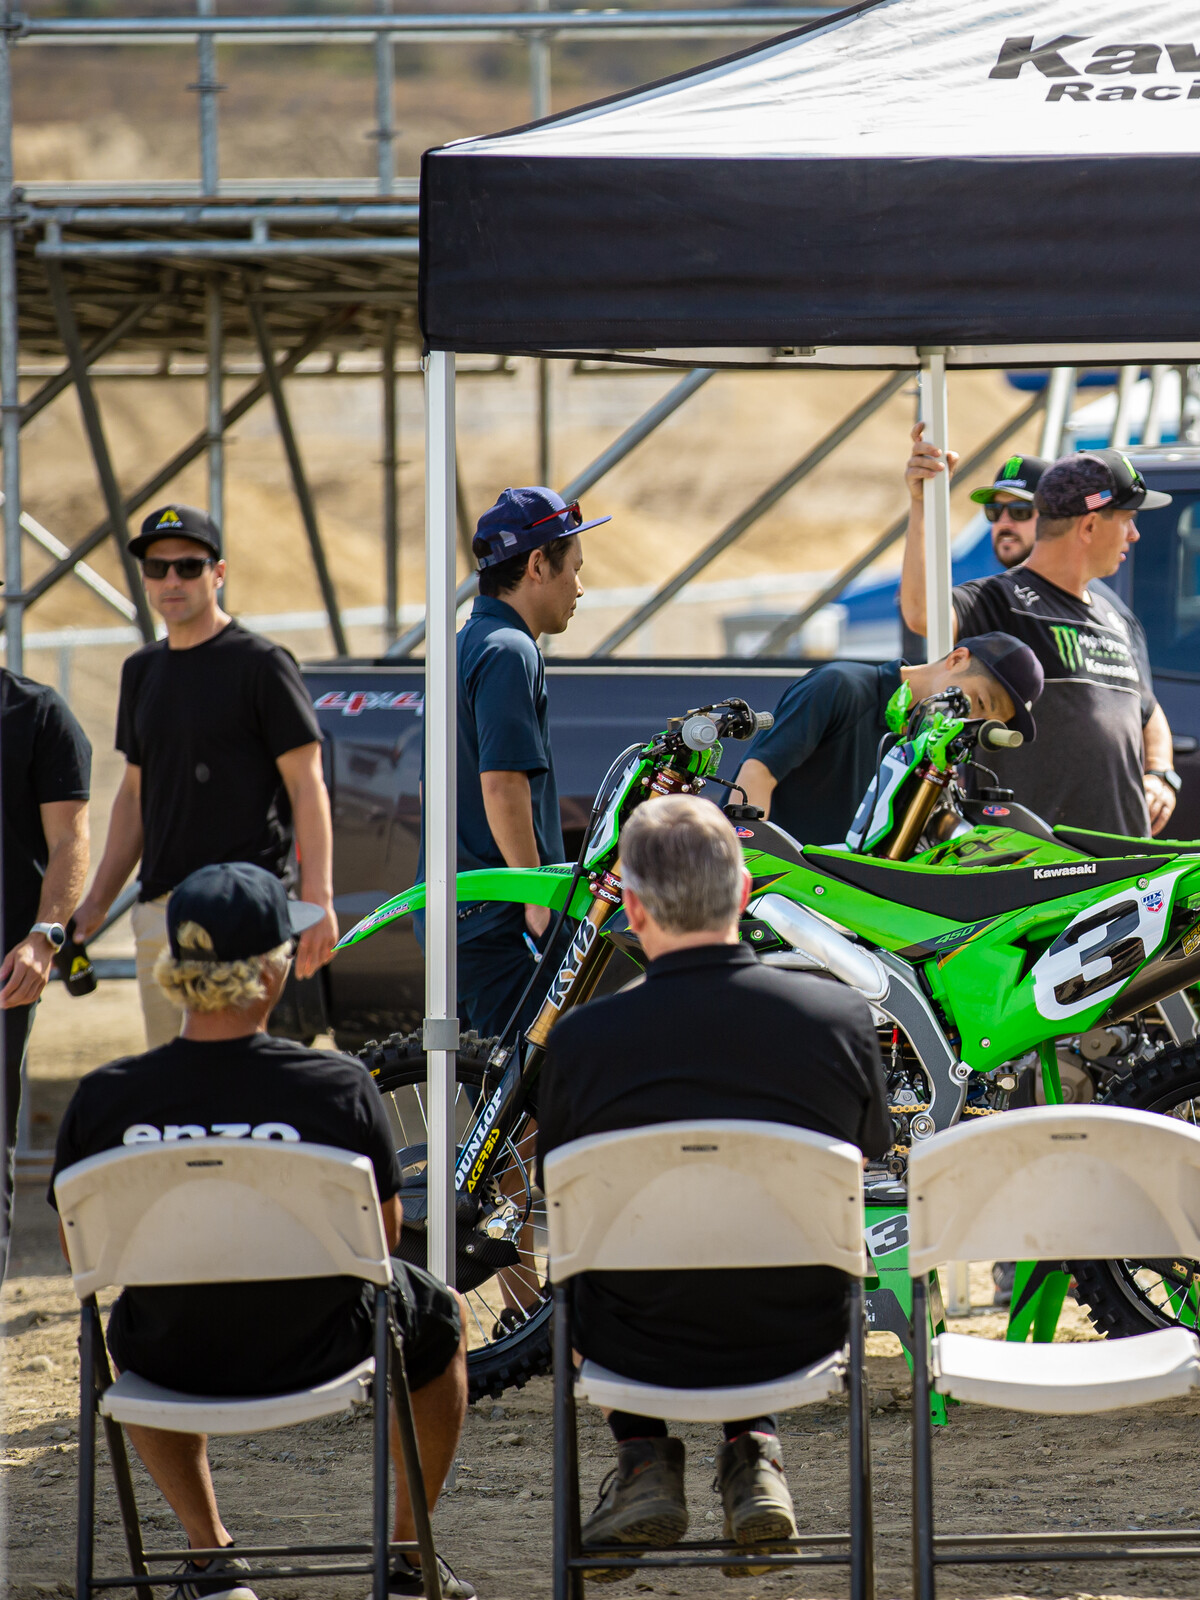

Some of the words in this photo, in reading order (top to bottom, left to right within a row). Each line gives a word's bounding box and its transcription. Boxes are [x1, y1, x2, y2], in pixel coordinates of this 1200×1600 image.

[1034, 863, 1097, 879] Kawasaki
[598, 888, 621, 904] ROCS
[934, 925, 977, 945] 450
[1049, 899, 1147, 1006] 3
[547, 915, 597, 1011] KYB
[455, 1086, 502, 1191] DUNLOP
[871, 1215, 909, 1256] 3
